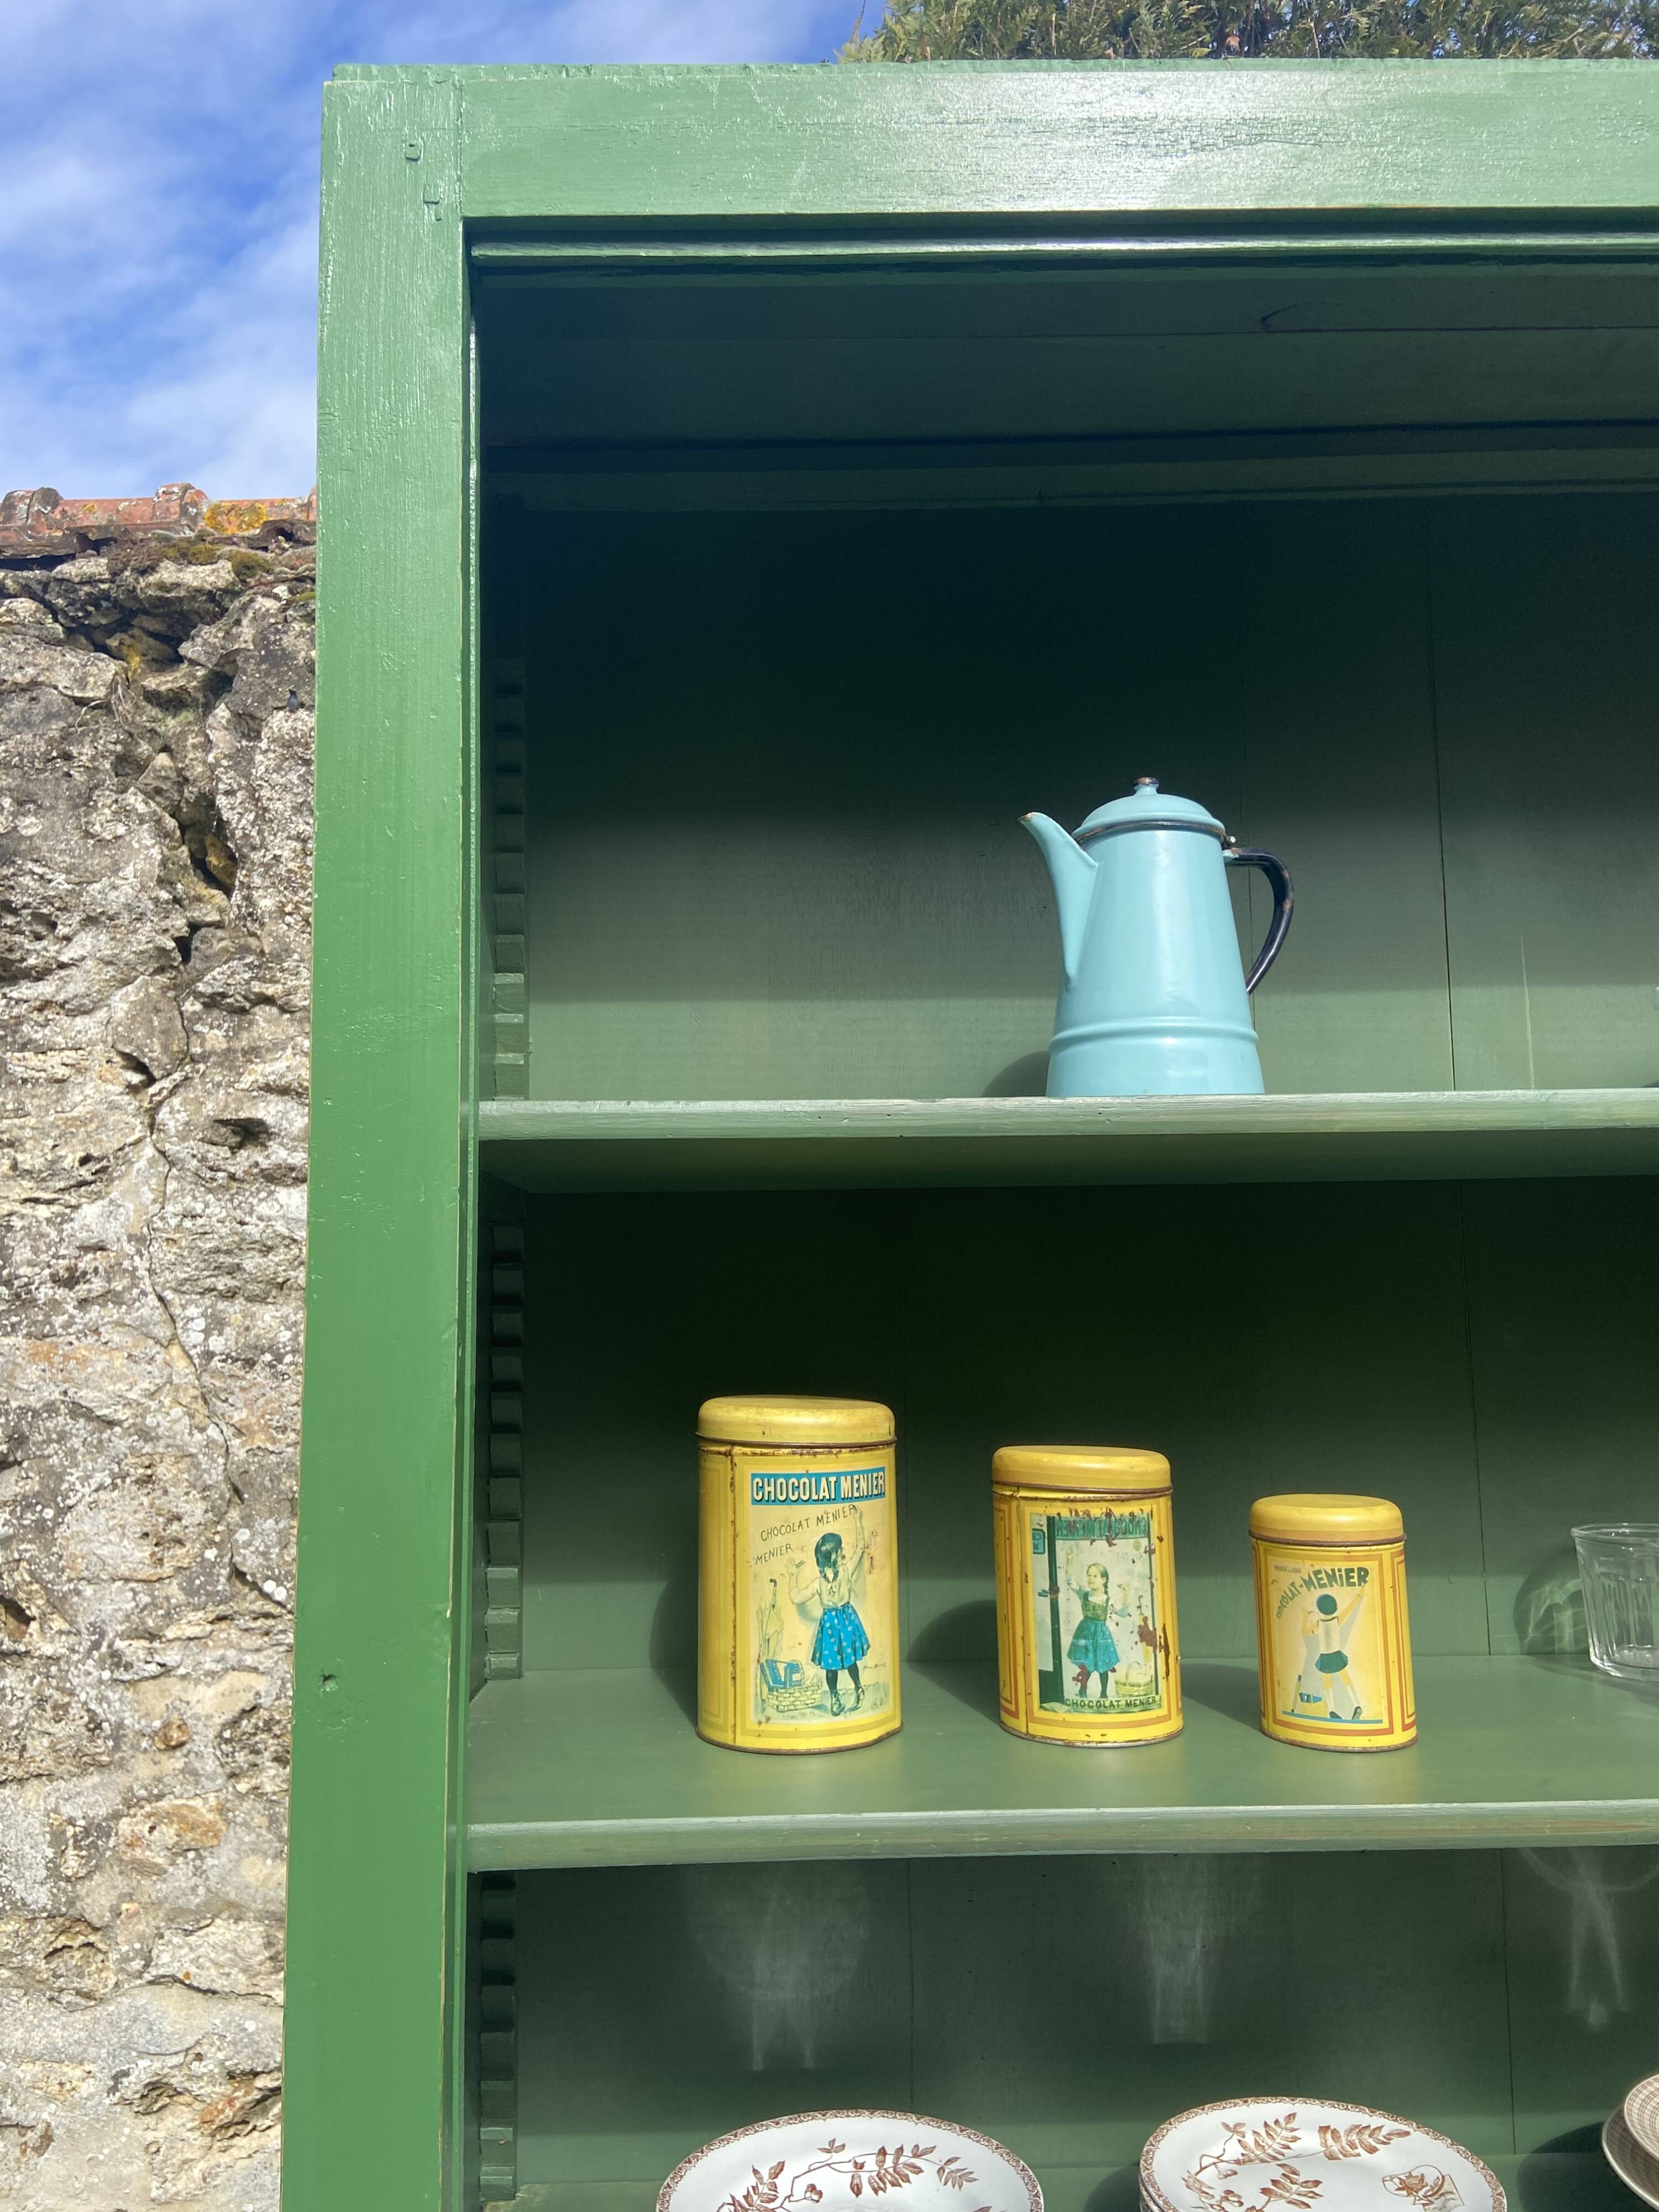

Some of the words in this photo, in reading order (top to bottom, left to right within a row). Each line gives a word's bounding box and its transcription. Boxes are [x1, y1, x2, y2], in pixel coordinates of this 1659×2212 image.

[753, 1477, 837, 1503] CHOCOLAT
[840, 1471, 885, 1500] MENIER
[760, 1517, 811, 1542] CHOCOLAT
[816, 1504, 858, 1527] MENIER
[755, 1543, 795, 1565] MENIER
[1065, 1698, 1121, 1709] CHOCOLAT
[1125, 1695, 1156, 1708] MENIER
